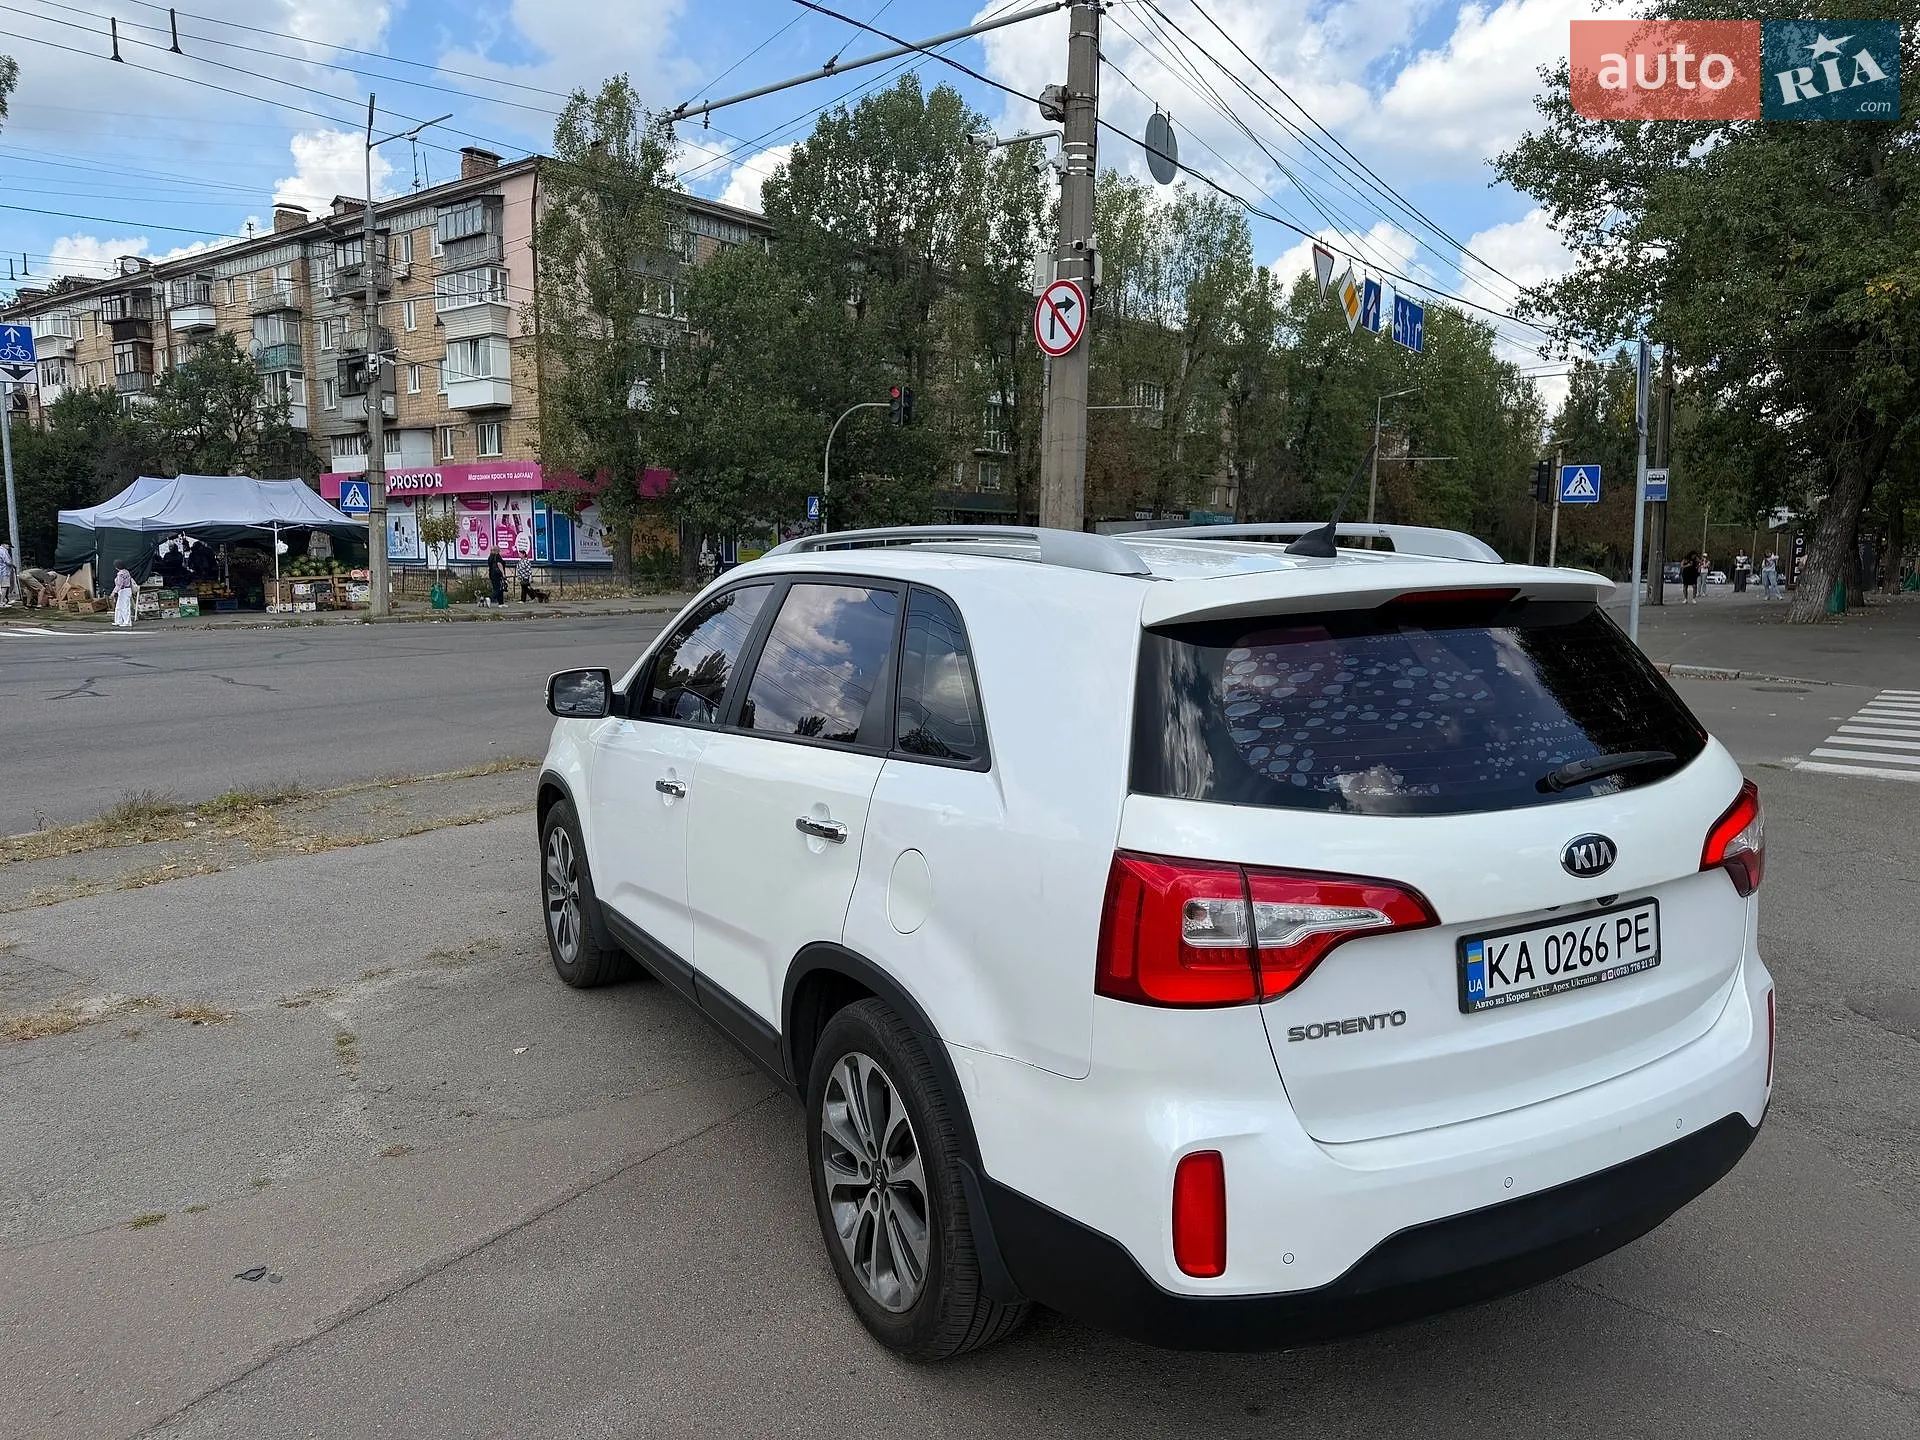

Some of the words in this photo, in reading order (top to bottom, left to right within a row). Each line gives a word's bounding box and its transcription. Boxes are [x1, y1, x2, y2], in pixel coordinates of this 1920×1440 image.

[1571, 841, 1613, 870] KIA
[1487, 940, 1536, 989] KA
[1544, 922, 1609, 976] 0266
[1616, 912, 1651, 959] PE
[1613, 966, 1630, 978] (073)
[1468, 979, 1484, 993] UA
[1552, 982, 1570, 993] Apex
[1571, 976, 1598, 988] Ukraine
[1474, 999, 1494, 1010] Авто
[1495, 997, 1505, 1006] из
[1506, 991, 1530, 1003] Кореи
[1287, 1009, 1407, 1043] SORENTO
